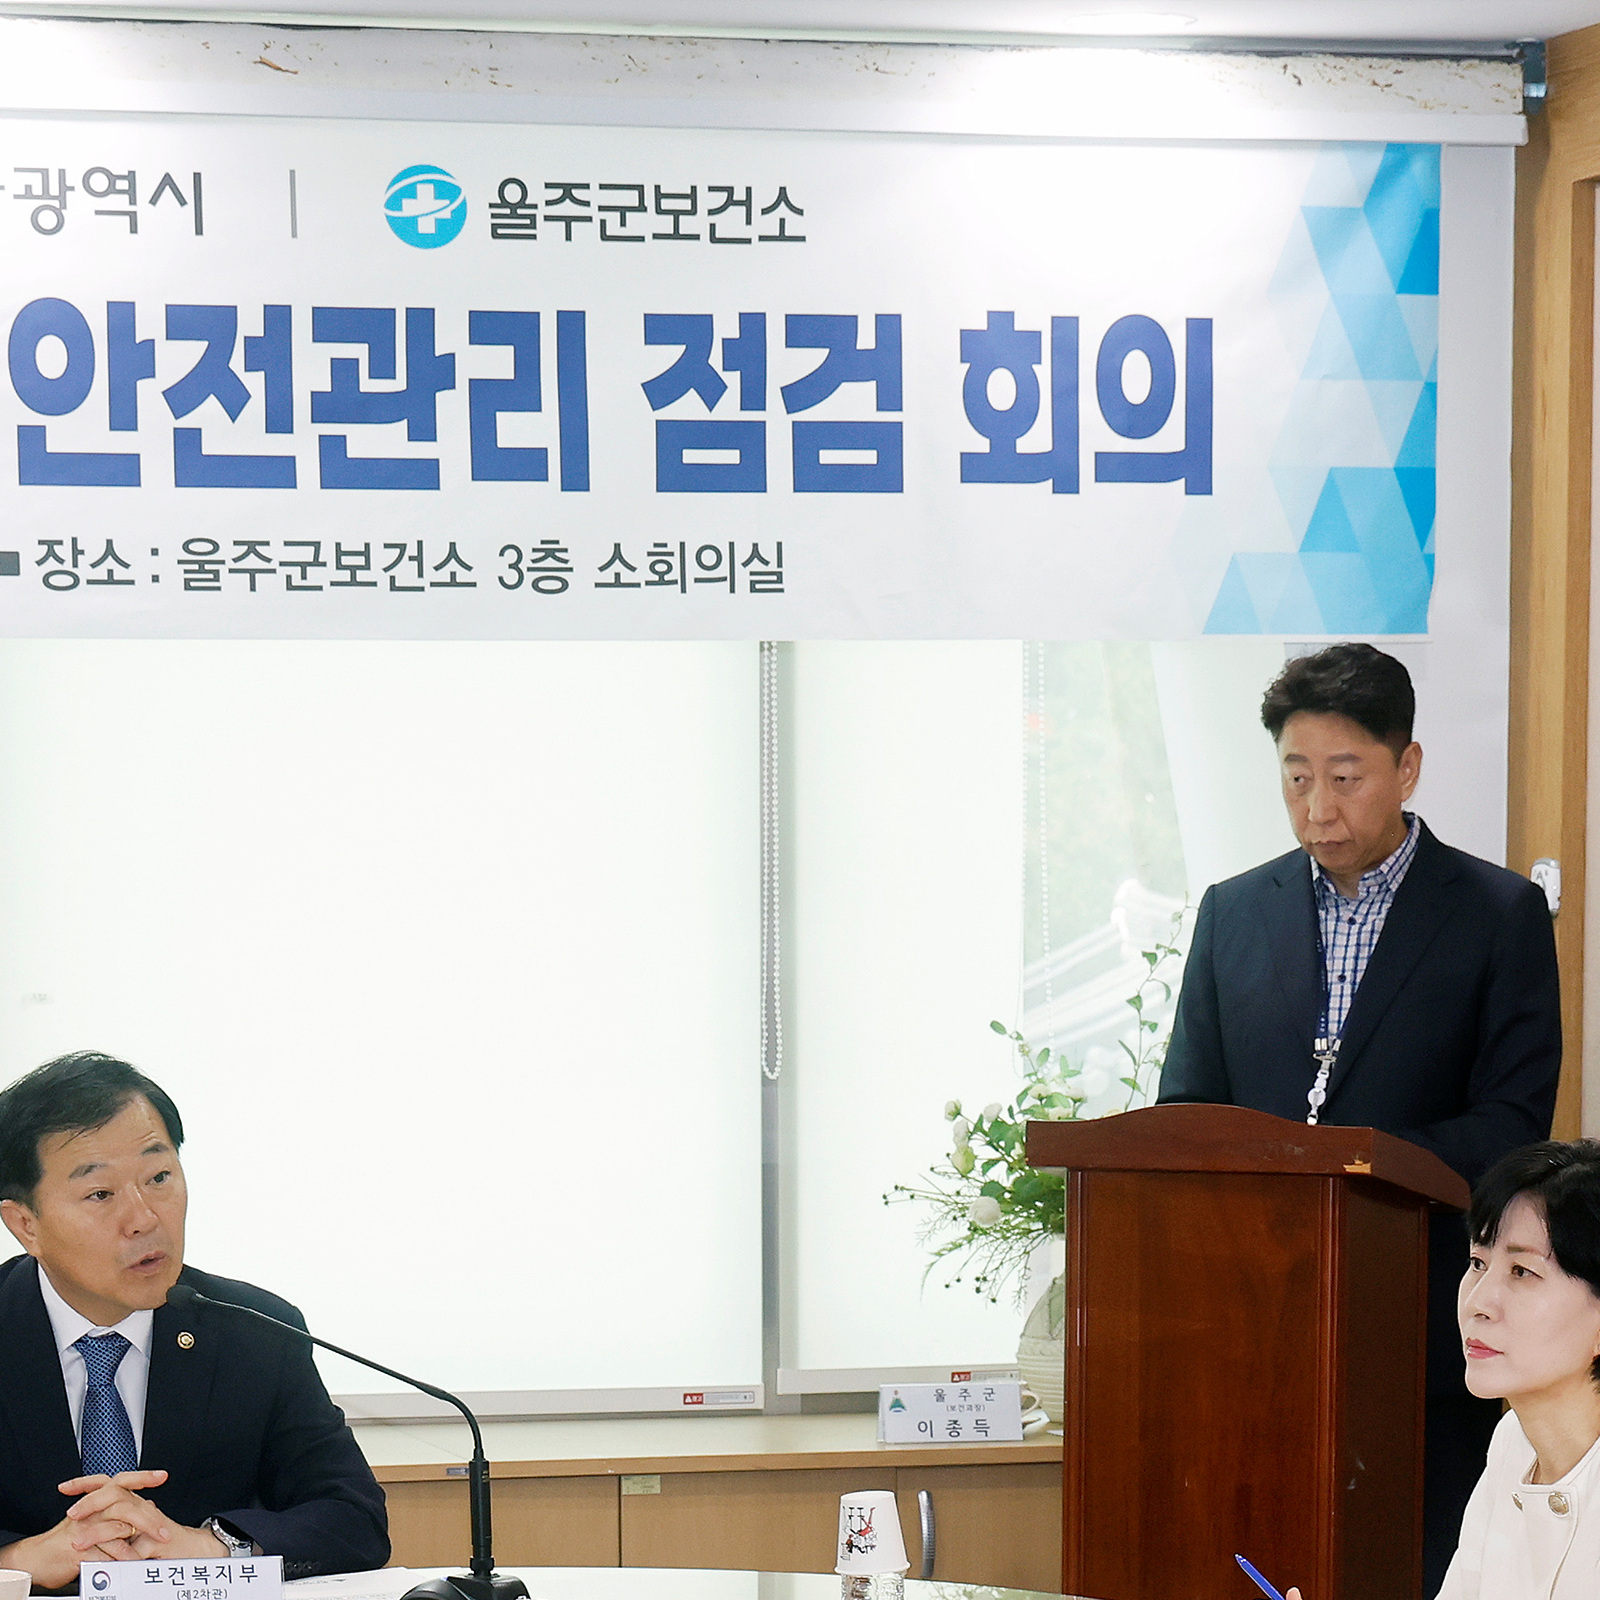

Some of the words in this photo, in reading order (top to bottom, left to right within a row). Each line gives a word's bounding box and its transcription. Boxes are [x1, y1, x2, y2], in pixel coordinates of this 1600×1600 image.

[488, 177, 807, 245] 울주군보건소
[7, 297, 591, 492] 안전관리
[640, 312, 904, 494] 점검
[959, 310, 1214, 496] 회의
[176, 537, 478, 593] 울주군보건소
[497, 539, 574, 595] 3층
[594, 541, 785, 594] 소회의실
[933, 1387, 997, 1404] 울주군
[917, 1418, 991, 1439] 이종득
[143, 1564, 259, 1587] 보건복지부
